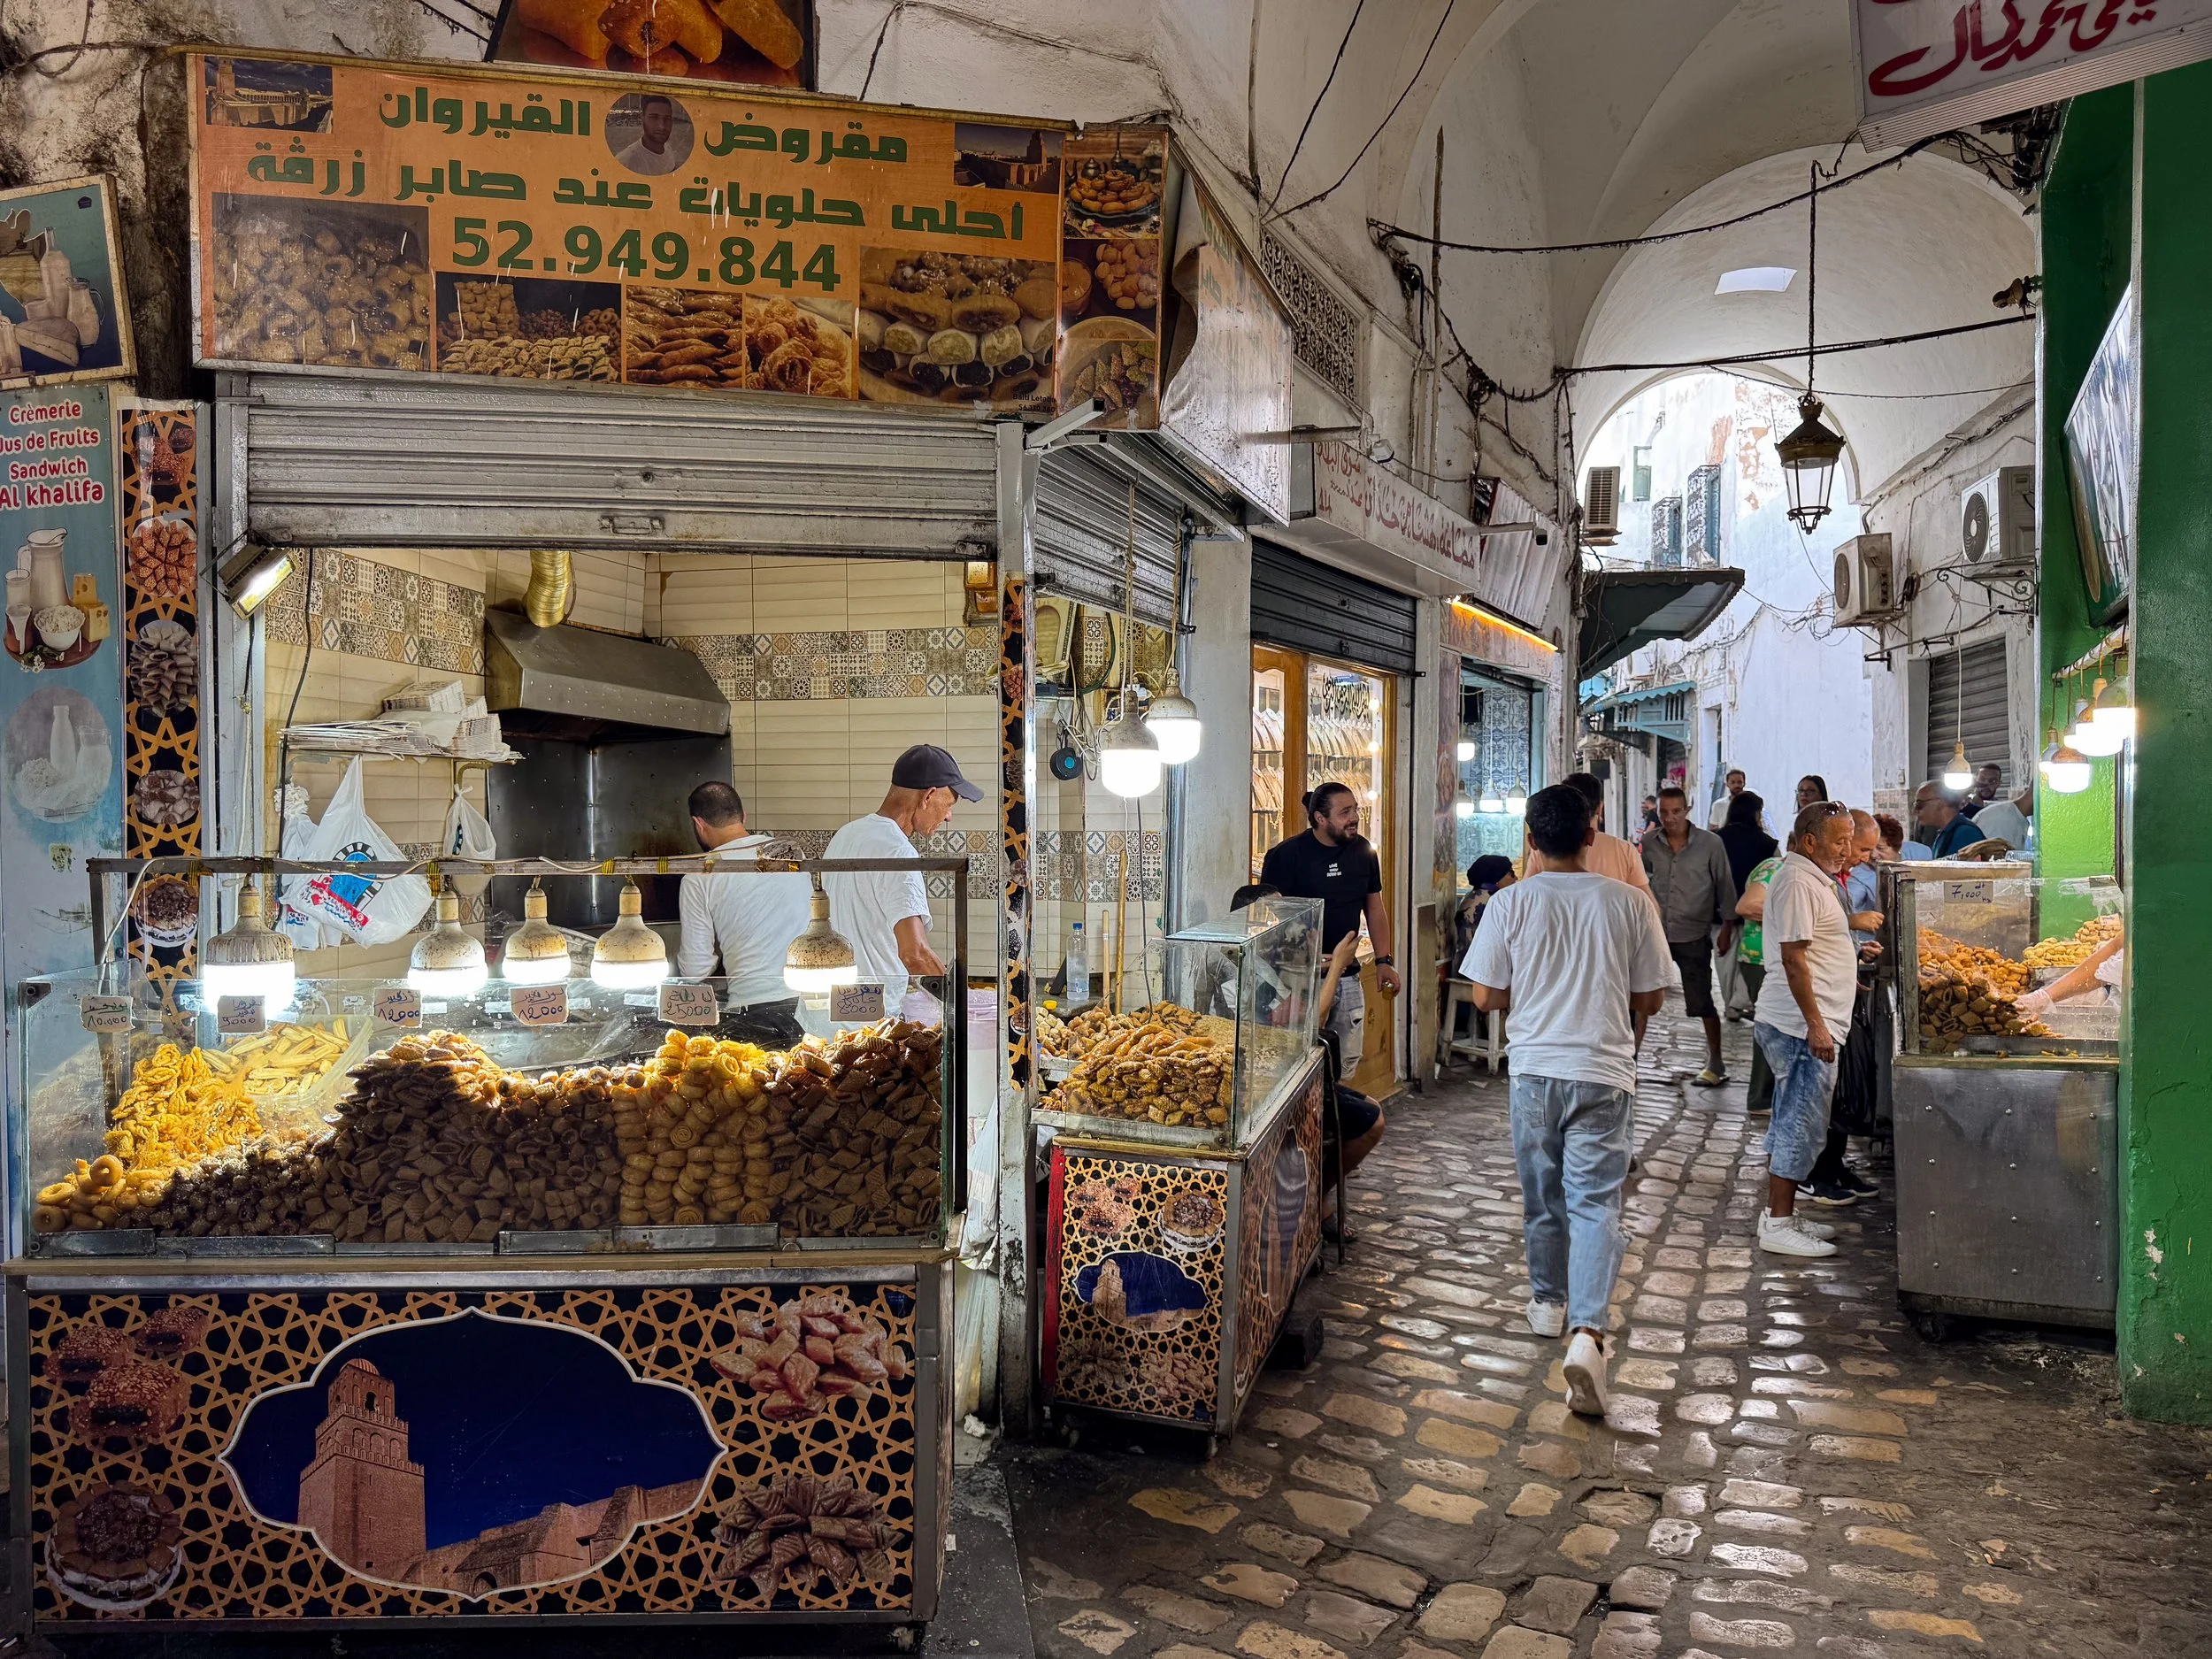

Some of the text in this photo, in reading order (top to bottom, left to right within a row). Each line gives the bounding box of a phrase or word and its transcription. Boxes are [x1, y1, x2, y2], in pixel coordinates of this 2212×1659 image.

[378, 86, 908, 165] مقروض القيروان
[394, 159, 526, 204] صابر
[553, 168, 653, 211] عند
[679, 176, 866, 230] حلويات
[452, 216, 841, 293] 52.949.844
[10, 401, 81, 424] Crèmerie
[27, 433, 45, 450] de
[50, 428, 99, 448] Fruits
[10, 457, 87, 480] Sandwich
[0, 487, 19, 508] Al
